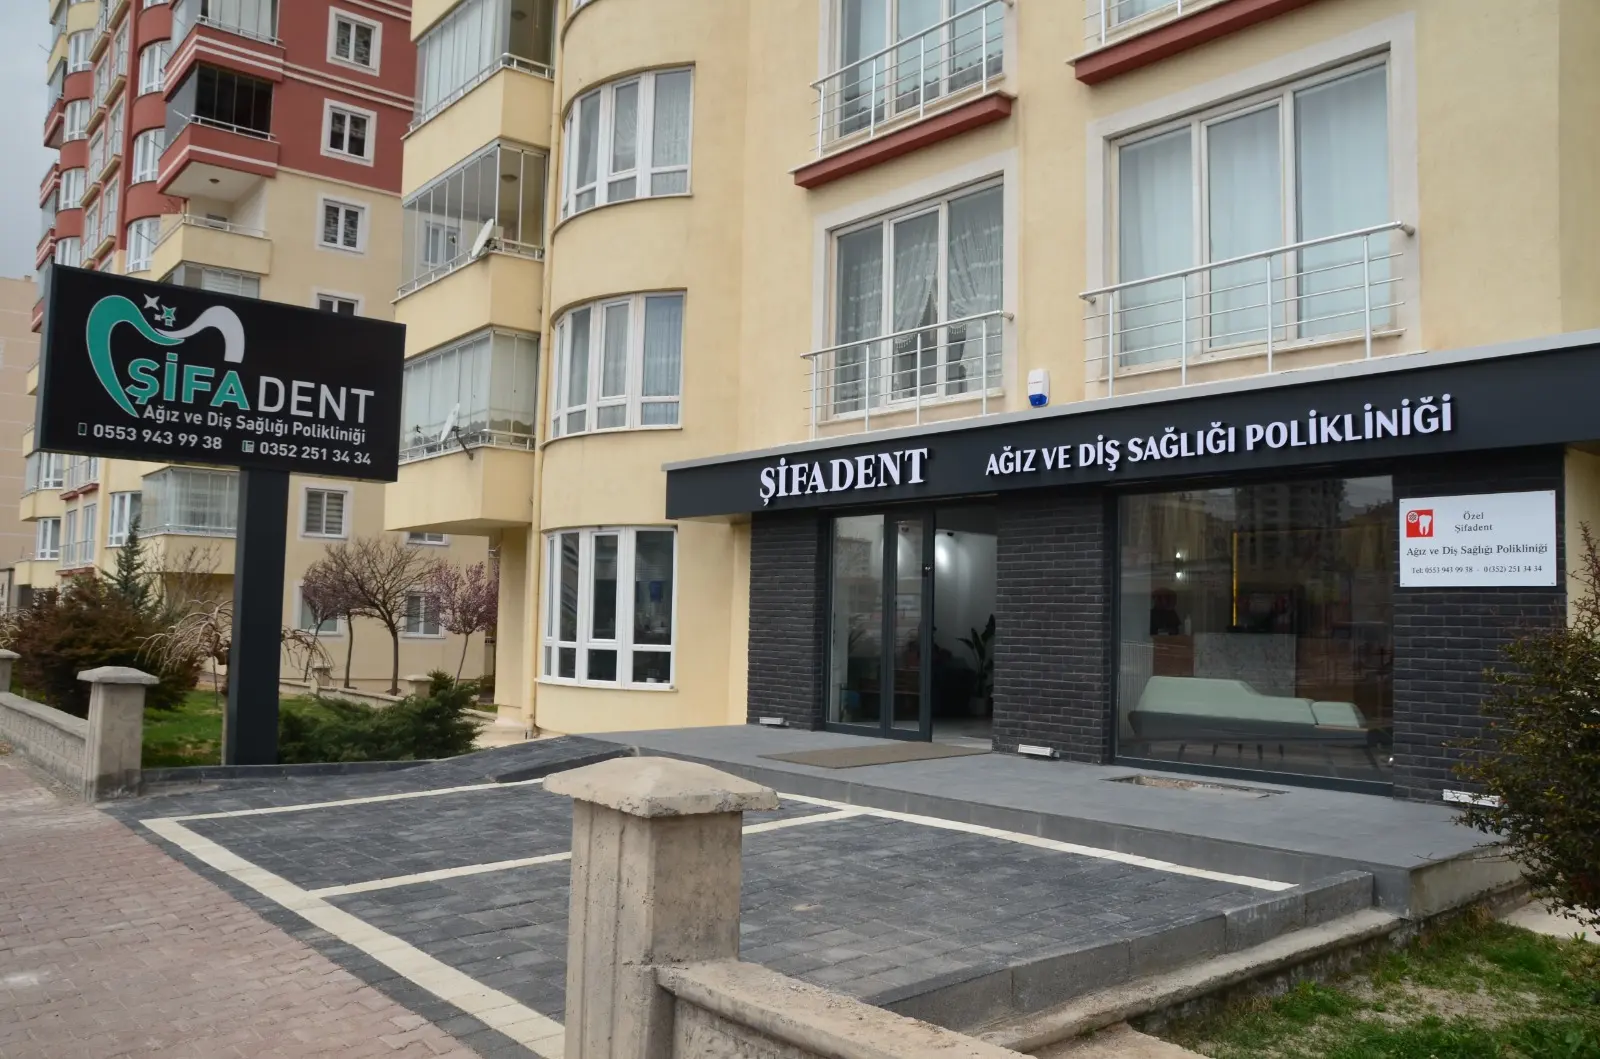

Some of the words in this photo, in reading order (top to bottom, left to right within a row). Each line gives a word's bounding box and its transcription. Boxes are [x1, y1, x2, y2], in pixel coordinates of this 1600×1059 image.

[143, 404, 179, 424] Ağız
[184, 412, 203, 424] ve
[207, 411, 232, 430] Diş
[236, 415, 288, 437] Sağlığı
[292, 421, 366, 445] Polikliniği
[985, 446, 1036, 476] AĞIZ
[1041, 444, 1072, 470] VE
[1078, 434, 1120, 472] DİŞ
[1127, 421, 1236, 463] SAĞLIĞI
[1245, 393, 1452, 452] POLİKLİNİĞİ
[93, 424, 137, 441] 0553
[142, 429, 173, 445] 943
[178, 433, 198, 447] 99
[202, 436, 222, 449] 38
[260, 442, 297, 457] 0352
[301, 447, 327, 460] 251
[332, 450, 350, 463] 34
[354, 452, 371, 465] 34
[759, 447, 928, 506] ŞİFADENT
[1463, 510, 1484, 520] Özel
[1454, 523, 1493, 534] Şifadent
[1406, 547, 1427, 557] Ağız
[1442, 546, 1458, 556] Diş
[1460, 545, 1493, 556] Sağlığı
[1496, 543, 1548, 555] Polikliniği
[1424, 566, 1440, 574] 0553
[1508, 565, 1520, 573] 251
